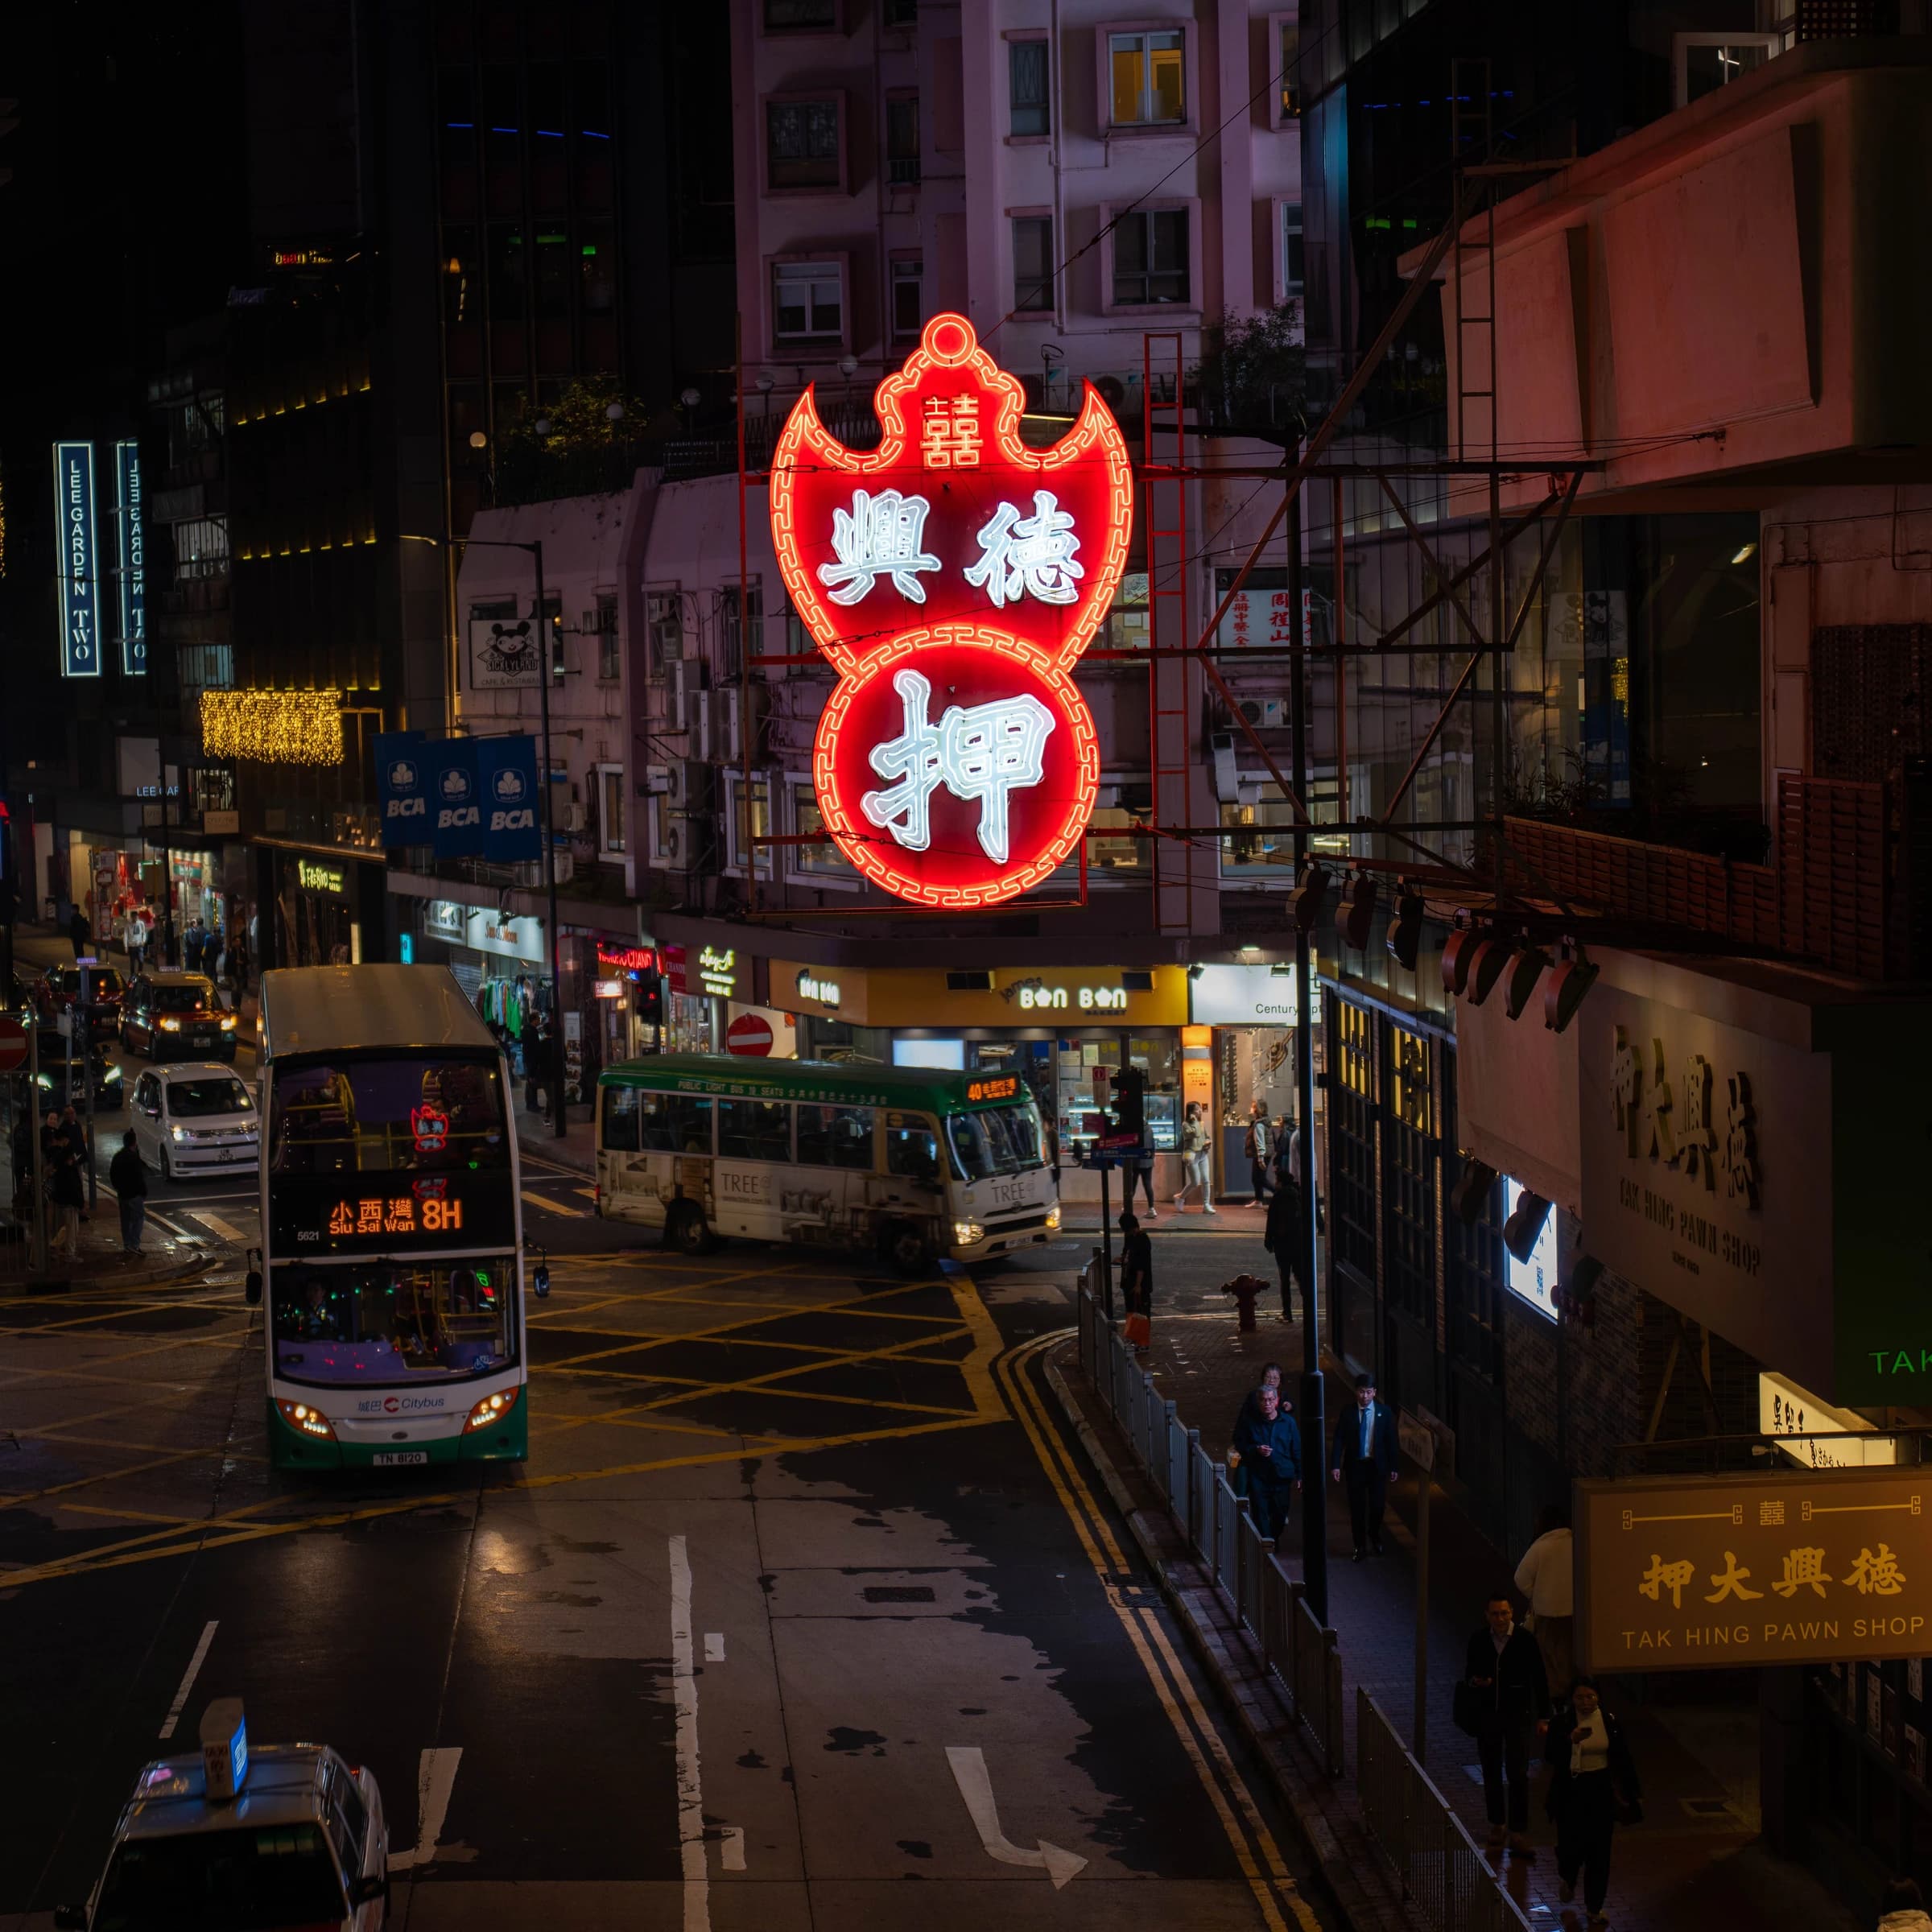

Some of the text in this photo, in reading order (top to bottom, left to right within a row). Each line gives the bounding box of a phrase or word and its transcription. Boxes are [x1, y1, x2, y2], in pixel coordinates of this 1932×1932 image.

[70, 459, 91, 660] LEE GARDEN TWO
[859, 667, 1057, 865] 押
[136, 786, 156, 797] LEE
[386, 797, 426, 818] BCA
[437, 806, 481, 829] BCA
[489, 808, 535, 832] BCA
[1256, 1003, 1298, 1017] Century
[678, 1080, 702, 1091] PUBLIC
[705, 1081, 725, 1092] LIGHT
[730, 1084, 745, 1095] BUS
[761, 1086, 783, 1097] SEATS
[721, 1173, 759, 1195] TREE
[991, 1182, 1026, 1203] TREE
[330, 1198, 414, 1221] 小西灣
[422, 1197, 463, 1230] 8H
[296, 1231, 320, 1242] 5621
[328, 1219, 415, 1235] Siu Sai Wan
[1620, 1177, 1641, 1213] TAK
[1645, 1189, 1675, 1232] HING
[1680, 1210, 1716, 1256] PAWN
[1723, 1229, 1761, 1278] SHOP
[402, 1397, 444, 1410] Citybus
[379, 1454, 422, 1463] TN 8120
[1622, 1616, 1926, 1650] TAK HING PAWN SHOP
